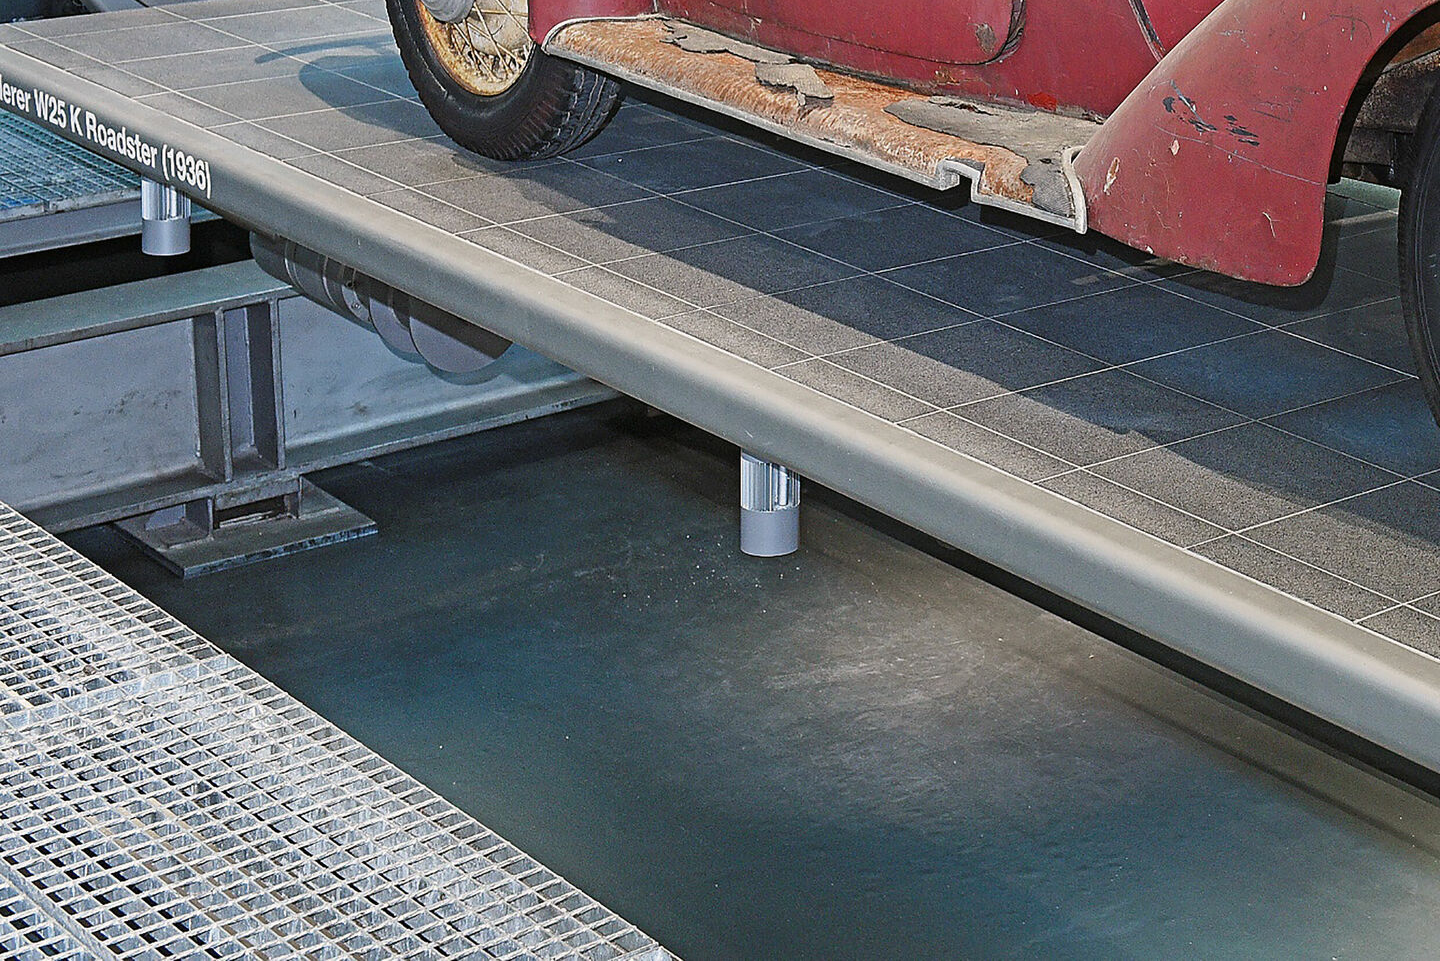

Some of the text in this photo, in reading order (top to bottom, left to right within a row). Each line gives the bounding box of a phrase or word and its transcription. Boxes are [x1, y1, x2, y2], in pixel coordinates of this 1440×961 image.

[34, 88, 67, 129] W25
[70, 104, 83, 137] K
[85, 111, 157, 168] Roadster
[162, 144, 211, 199] (1936)
